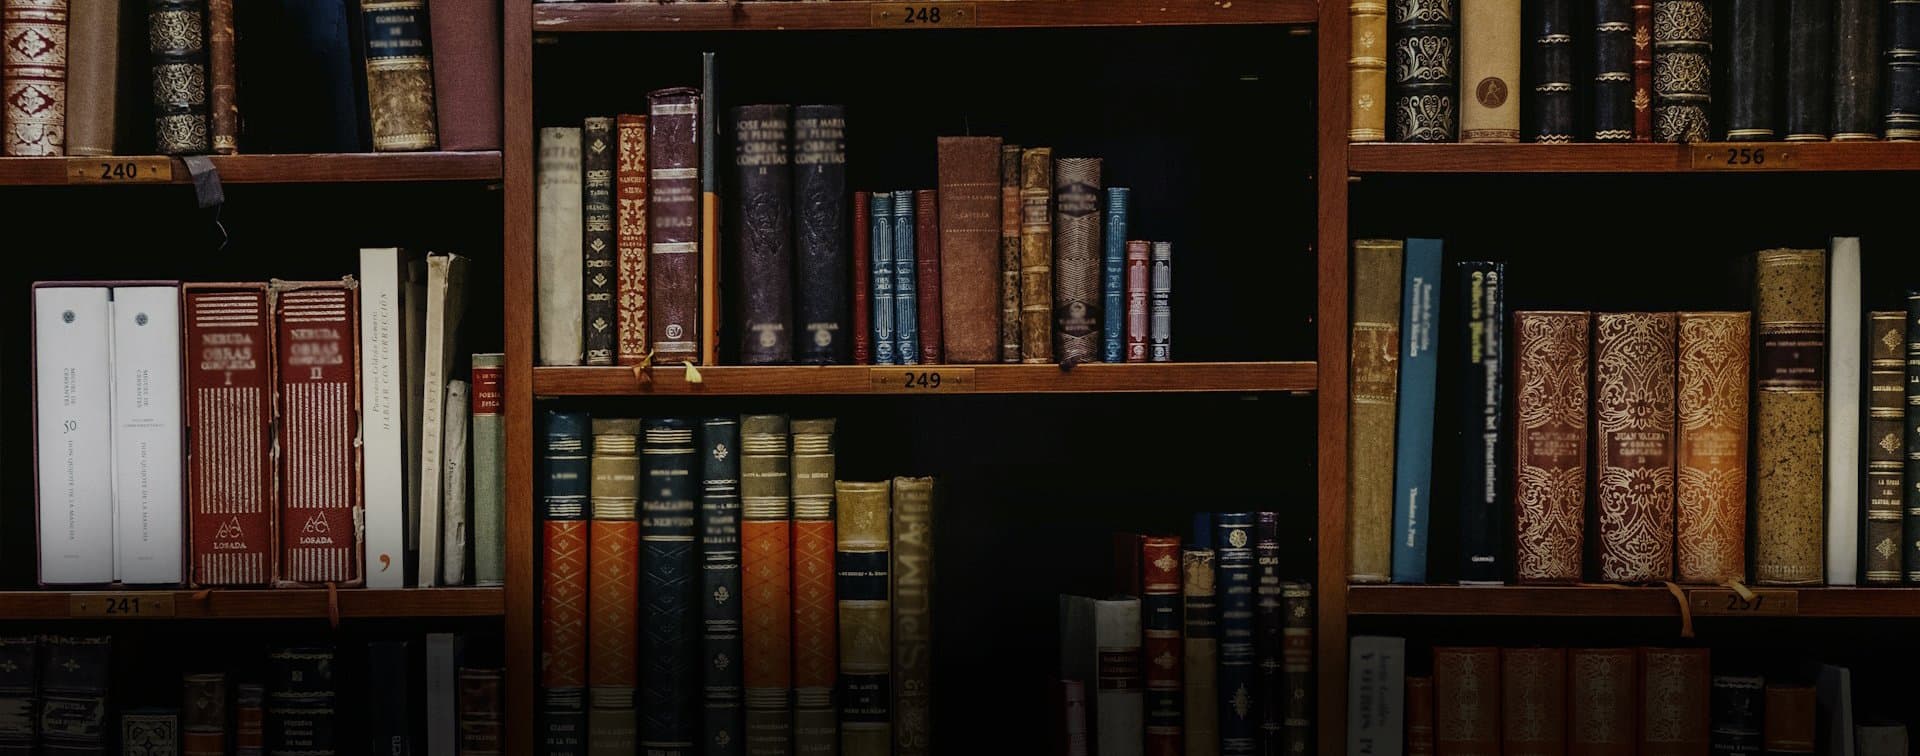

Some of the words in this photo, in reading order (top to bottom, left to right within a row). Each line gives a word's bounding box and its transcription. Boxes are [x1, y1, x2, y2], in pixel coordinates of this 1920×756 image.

[904, 7, 941, 24] 248
[1727, 149, 1765, 165] 256
[101, 163, 137, 180] 240
[202, 333, 253, 345] NERUDA
[290, 329, 341, 340] NERUDA
[203, 347, 252, 360] OBRAS
[291, 342, 340, 355] OBRAS
[224, 371, 232, 386] I
[310, 366, 323, 379] II
[904, 372, 940, 389] 249
[213, 542, 248, 550] LOSADA
[300, 536, 334, 545] LOSADA
[106, 598, 140, 615] 241
